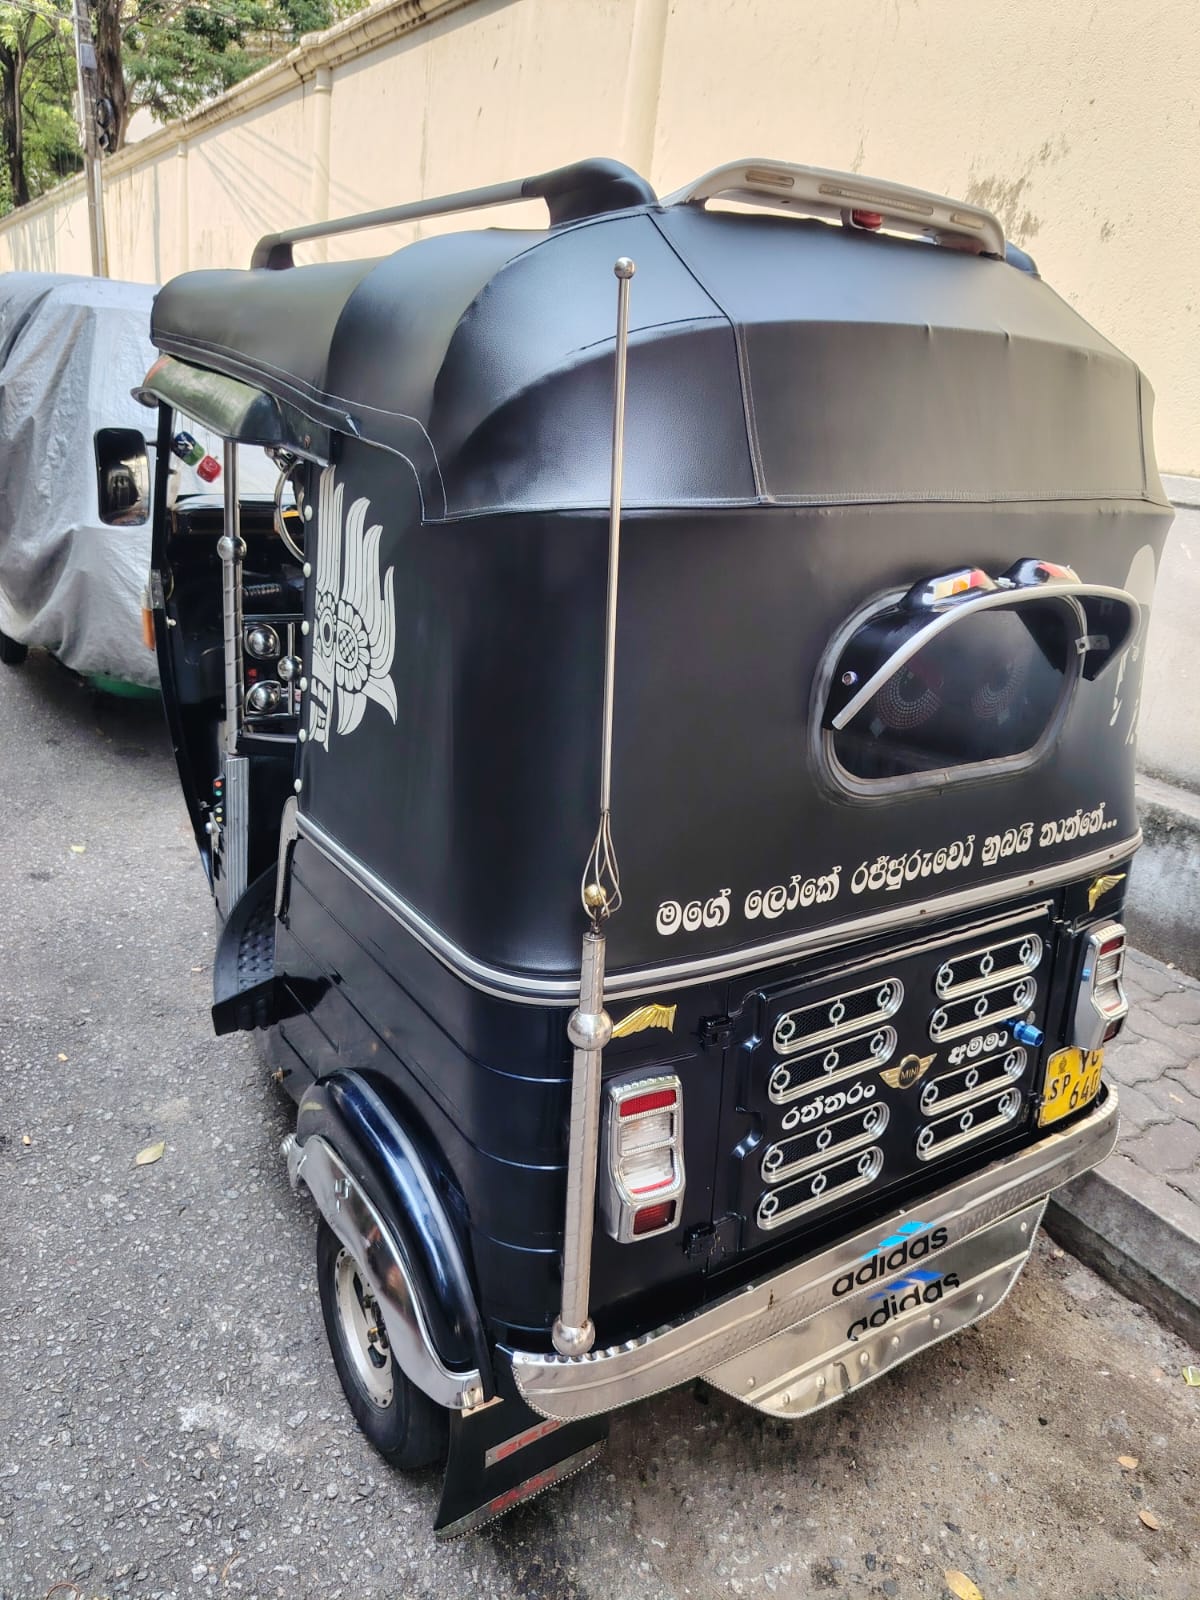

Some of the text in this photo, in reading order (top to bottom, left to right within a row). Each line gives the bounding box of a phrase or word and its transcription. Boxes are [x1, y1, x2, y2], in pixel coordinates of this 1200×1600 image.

[656, 888, 732, 936] මගේ
[744, 865, 842, 920] ලෝකේ
[850, 834, 976, 895] රජ්ජුරුවෝ
[900, 1065, 920, 1081] MINI
[947, 1030, 1008, 1066] අම්මා
[781, 1081, 876, 1131] රත්තරං
[1048, 1074, 1072, 1101] SP
[832, 1226, 948, 1297] adidas
[846, 1272, 960, 1342] adidas
